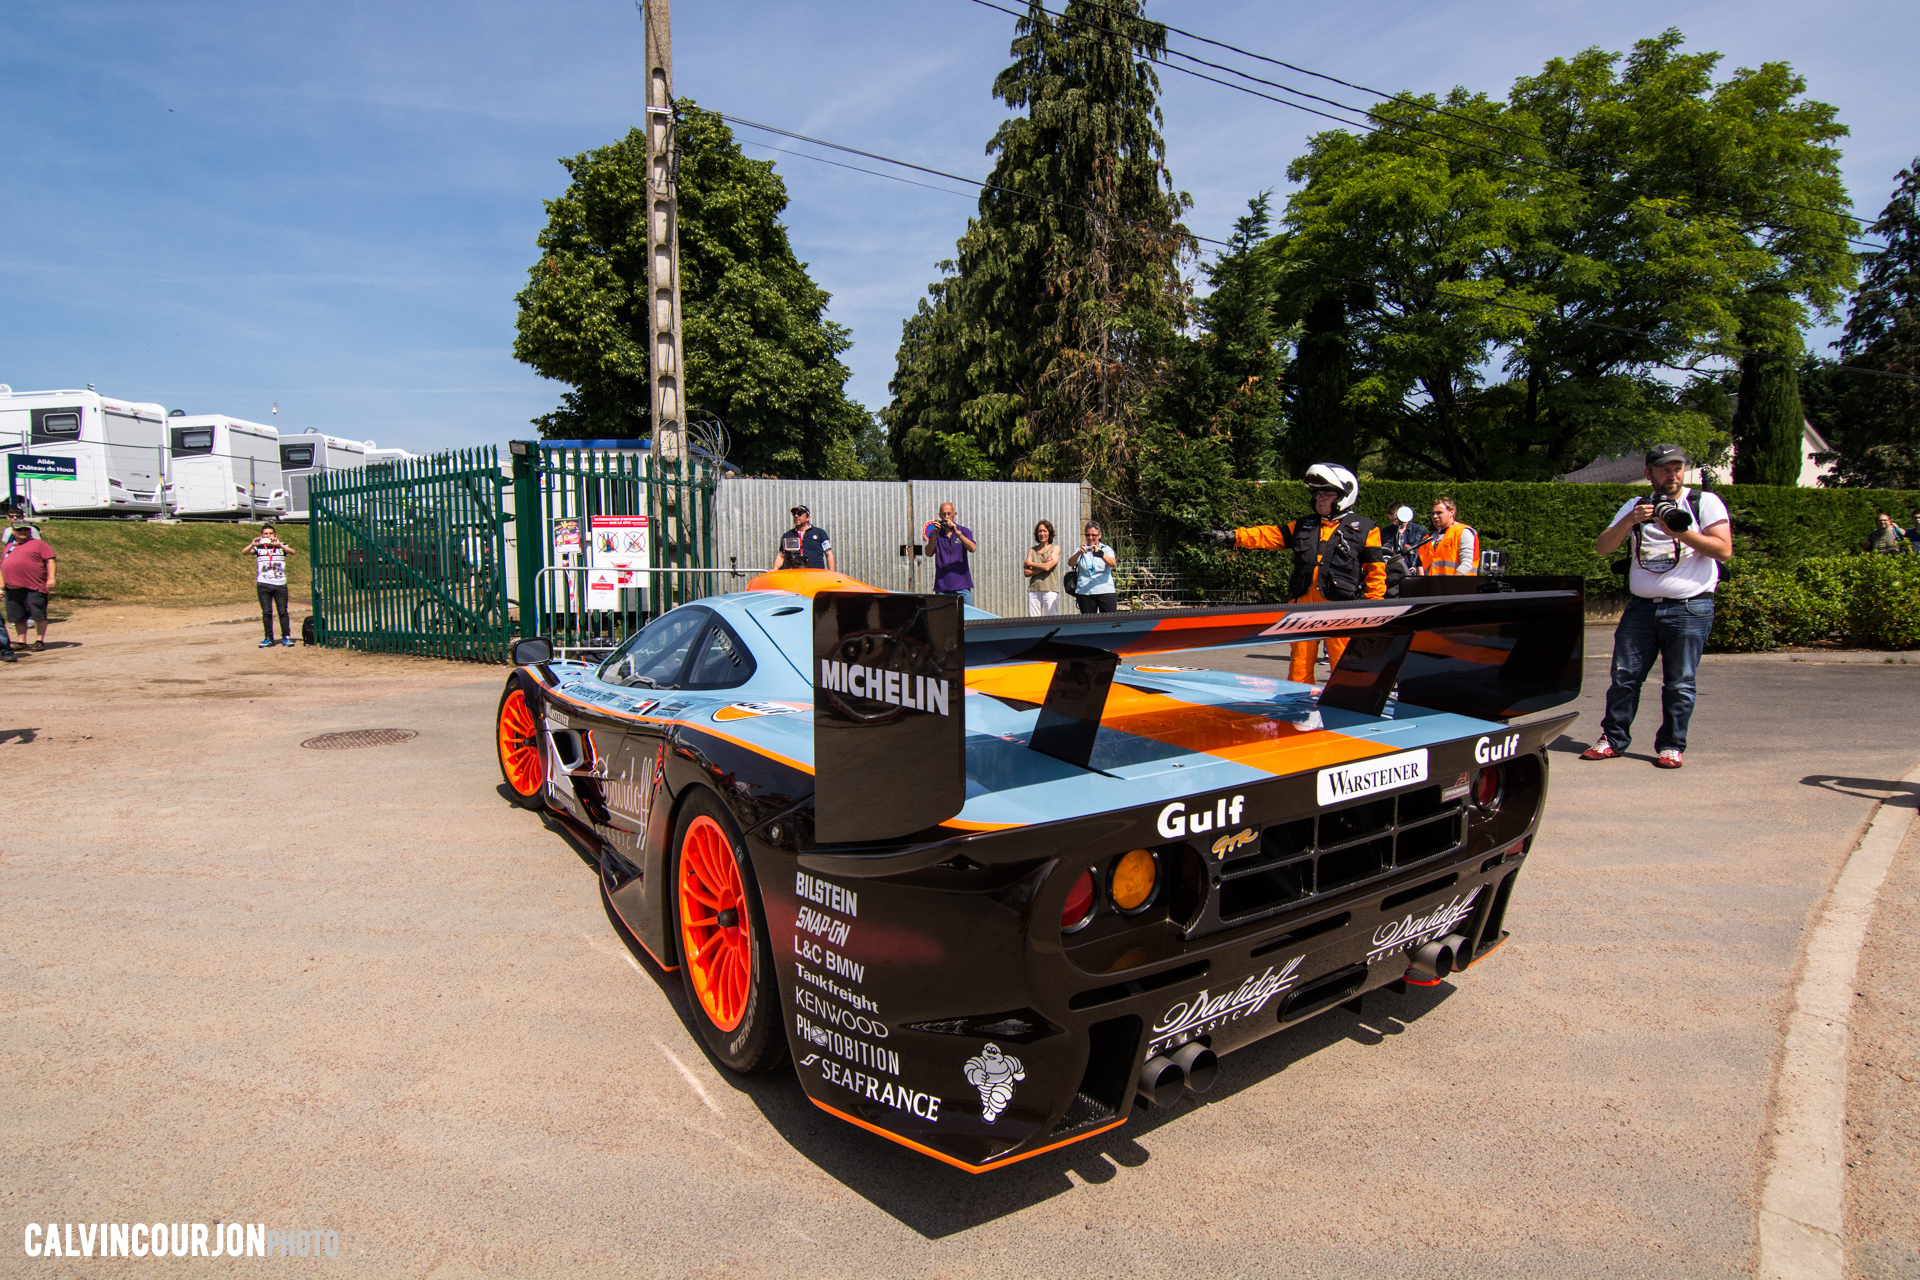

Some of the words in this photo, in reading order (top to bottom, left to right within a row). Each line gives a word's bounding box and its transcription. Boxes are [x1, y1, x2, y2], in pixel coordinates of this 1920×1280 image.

[1274, 615, 1395, 632] WARSTEINER
[822, 659, 949, 716] MICHELIN
[1475, 734, 1520, 764] Gulf
[1328, 762, 1419, 797] WARSTEINER
[1157, 795, 1245, 839] Gulf
[796, 872, 857, 917] BILSTEIN
[1372, 884, 1484, 947] Davidoff
[794, 935, 822, 964] L&C
[826, 950, 865, 984] BMW
[1367, 934, 1431, 965] CLASSIC
[795, 962, 879, 1014] Tankfreight
[1153, 954, 1306, 1033] Davidoff
[795, 985, 889, 1039] KENWOOD
[1150, 1010, 1241, 1055] CLASSIC
[821, 1058, 941, 1122] SEAFRANCE
